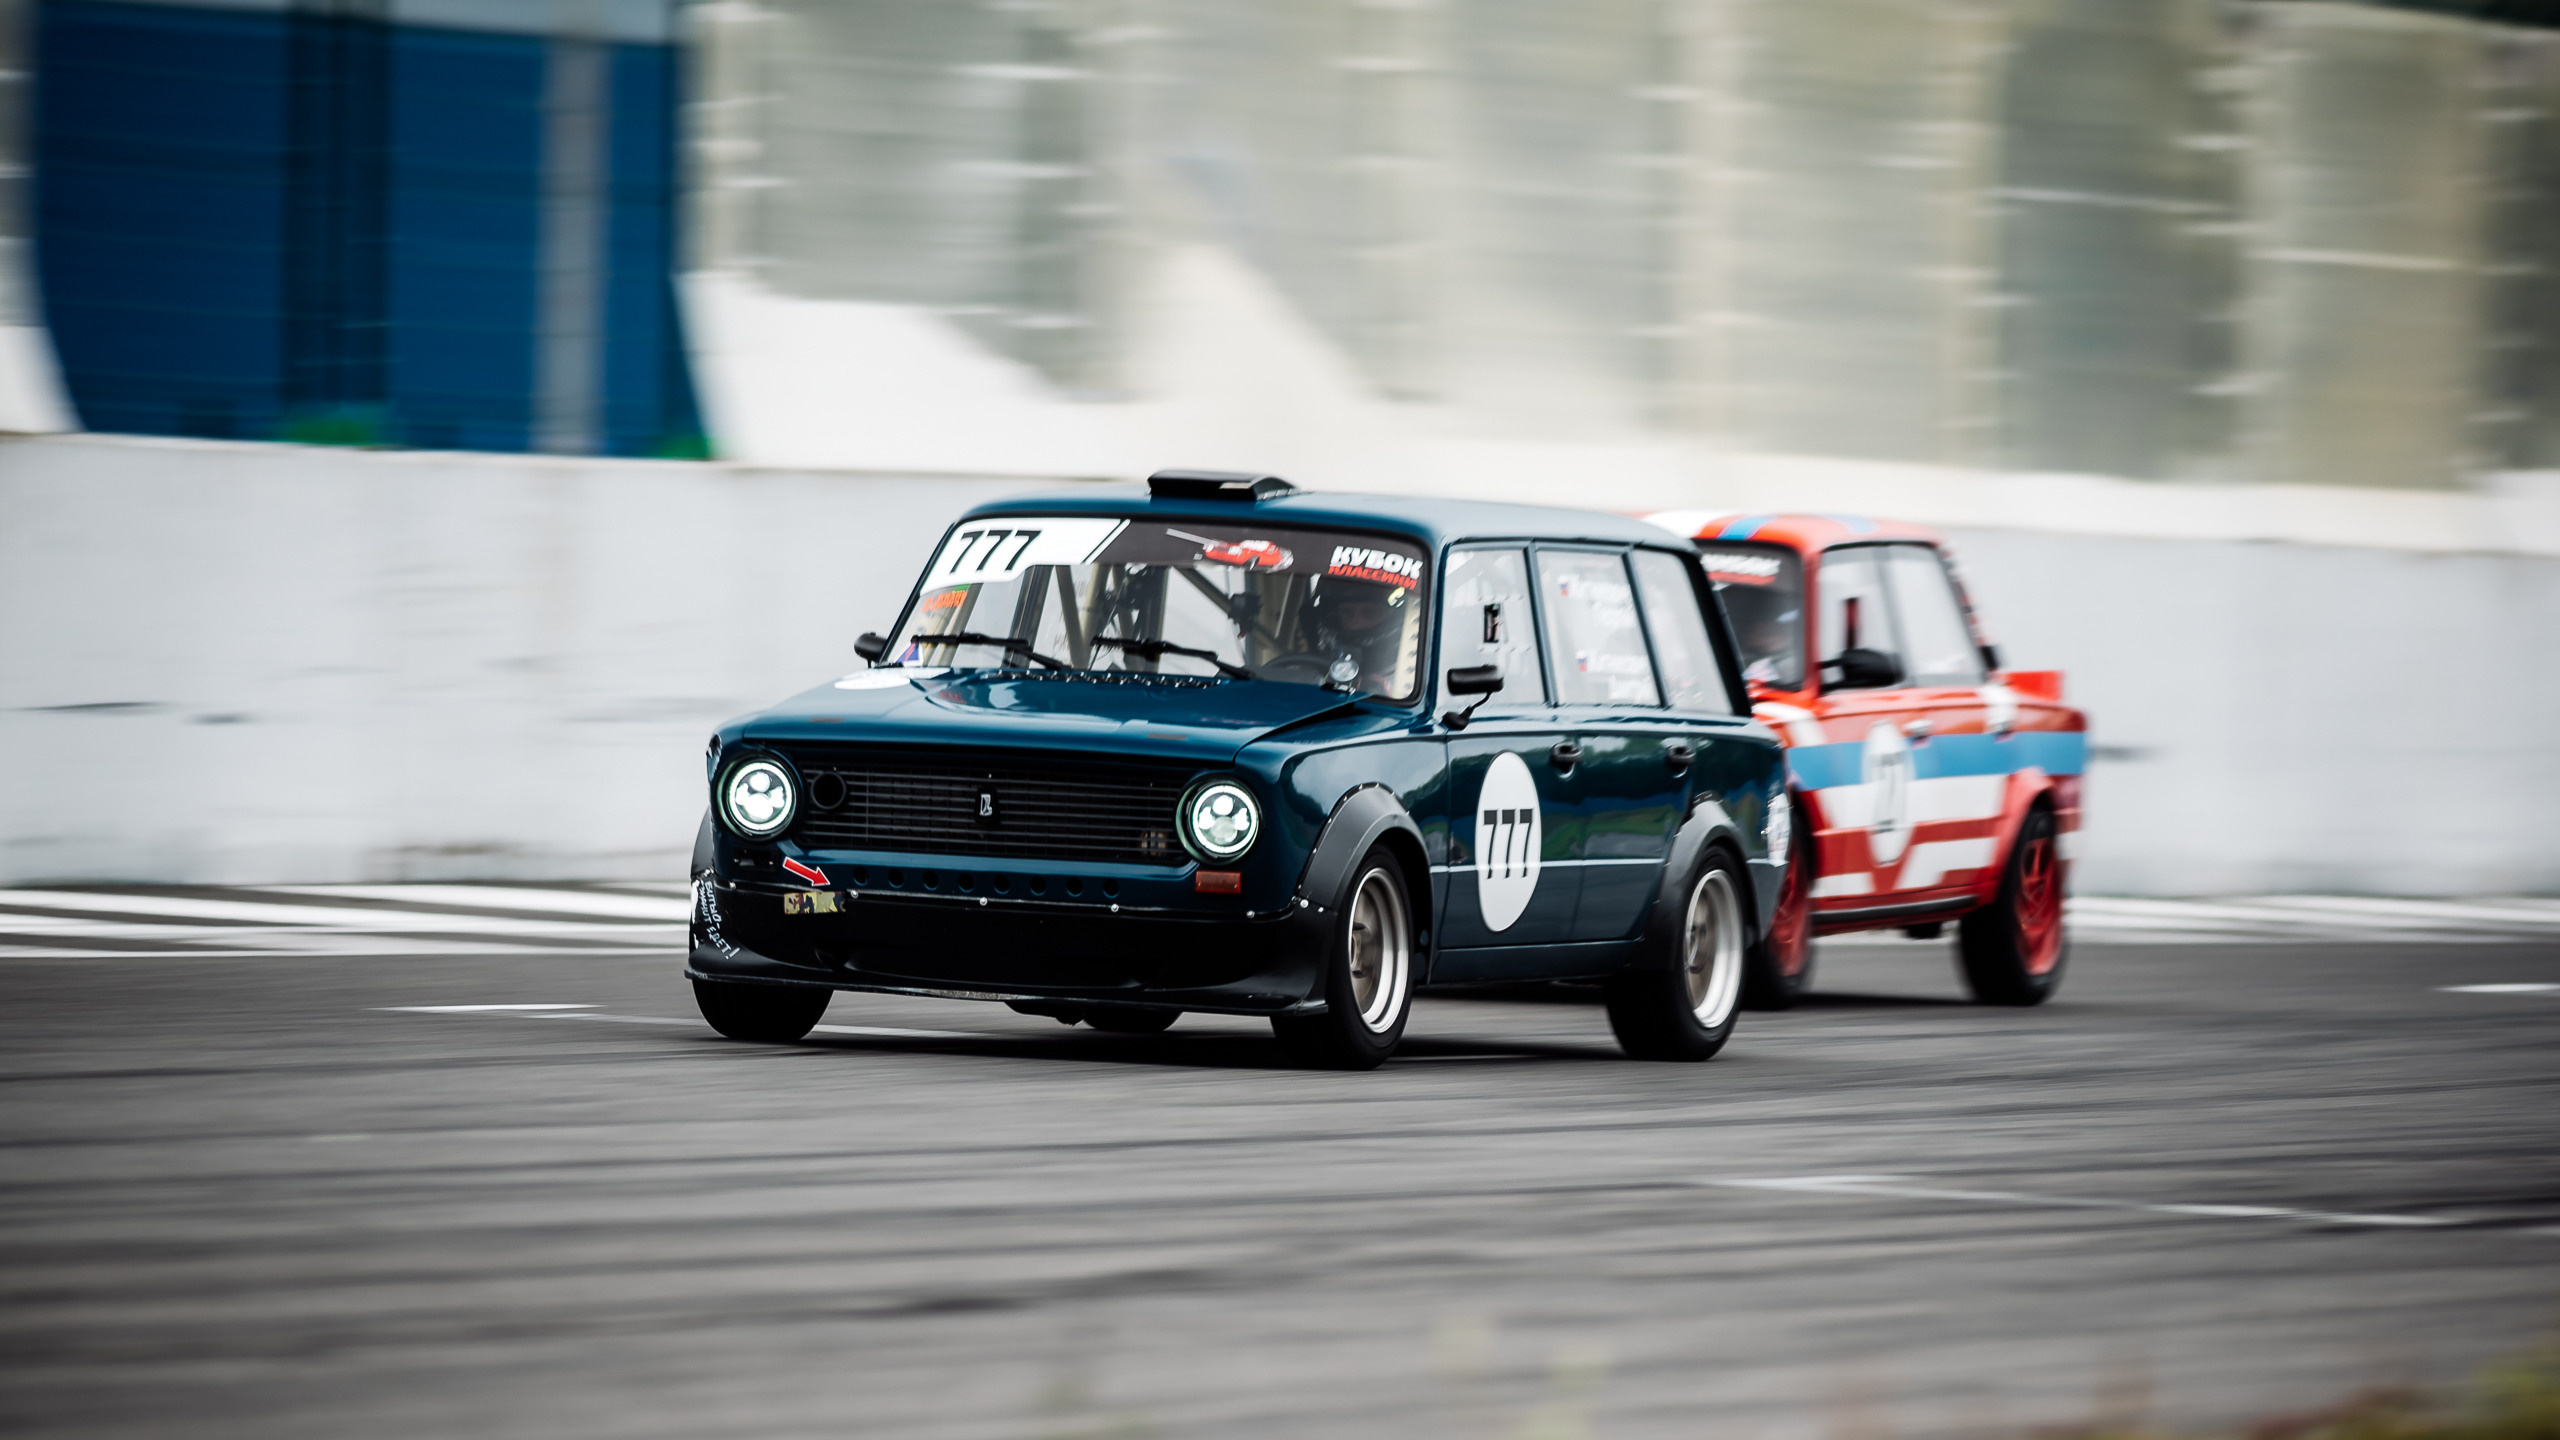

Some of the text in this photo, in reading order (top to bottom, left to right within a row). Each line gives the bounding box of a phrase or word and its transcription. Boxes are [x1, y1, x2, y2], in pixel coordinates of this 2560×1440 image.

[950, 529, 1042, 573] 777
[1329, 545, 1424, 580] КУБОК
[1483, 808, 1534, 879] 777
